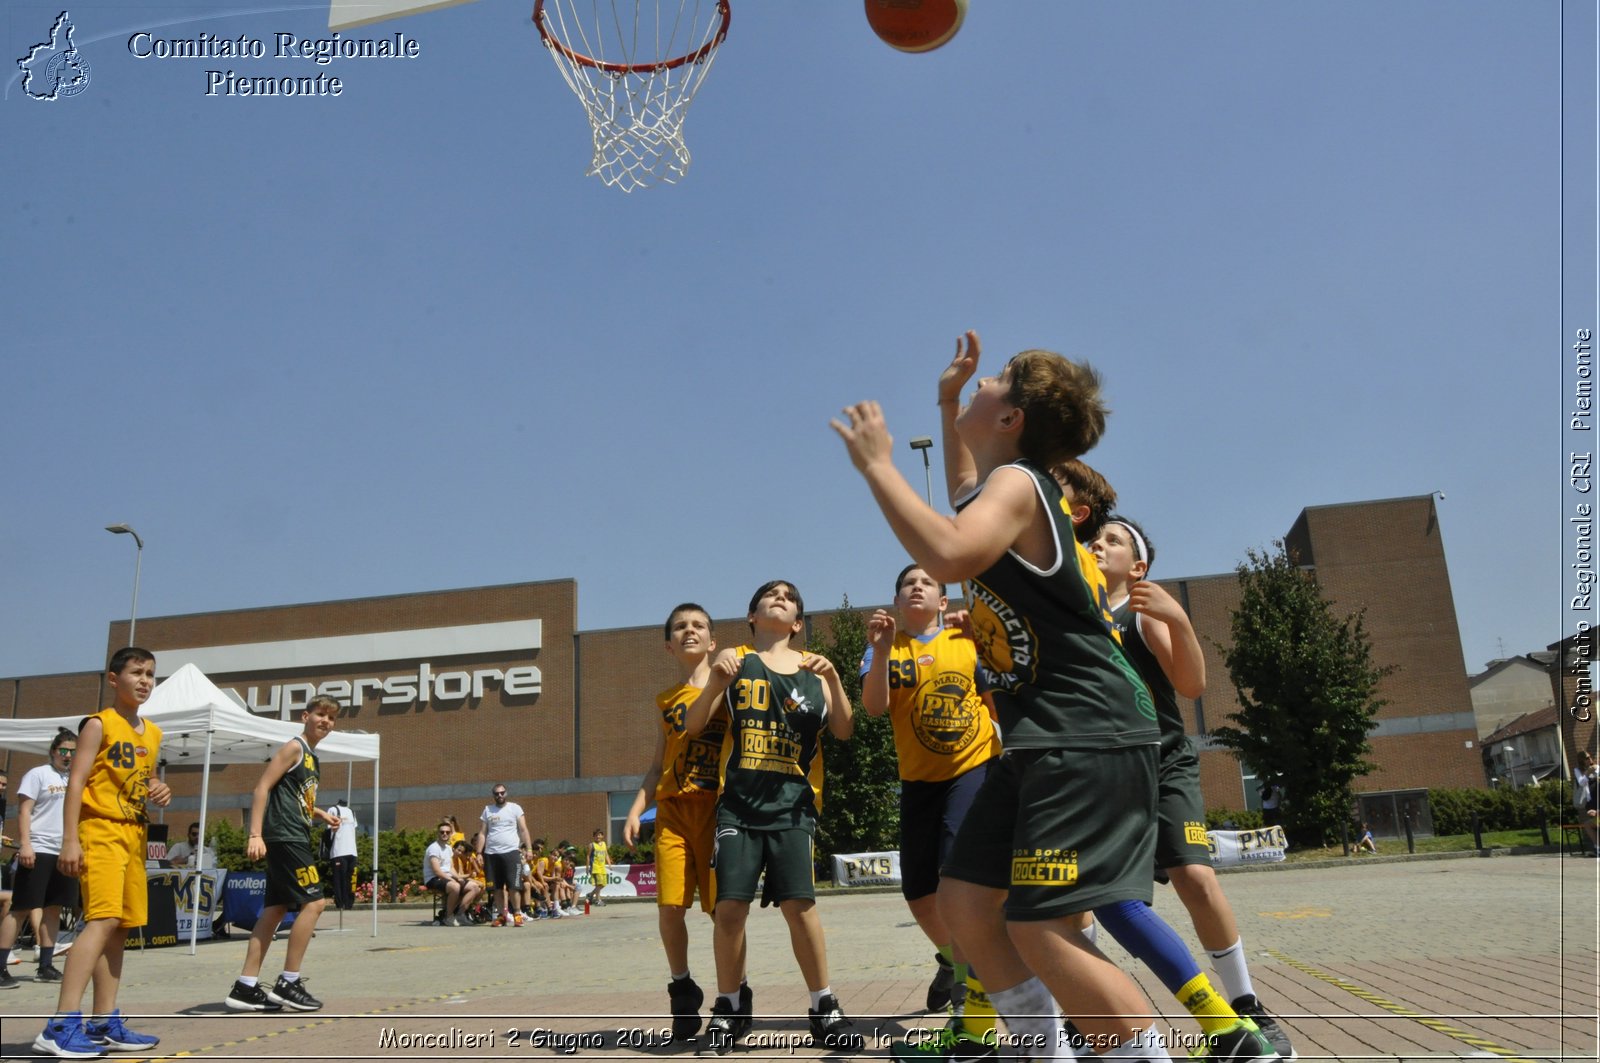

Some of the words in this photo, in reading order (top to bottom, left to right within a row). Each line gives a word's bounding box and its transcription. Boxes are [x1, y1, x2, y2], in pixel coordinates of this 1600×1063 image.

[889, 658, 917, 689] 69
[221, 663, 541, 721] uperstore
[735, 678, 771, 711] 30
[107, 741, 135, 769] 49
[1035, 849, 1078, 858] BOSCO
[296, 865, 320, 887] 50
[846, 858, 891, 878] PMS
[227, 877, 267, 889] molten
